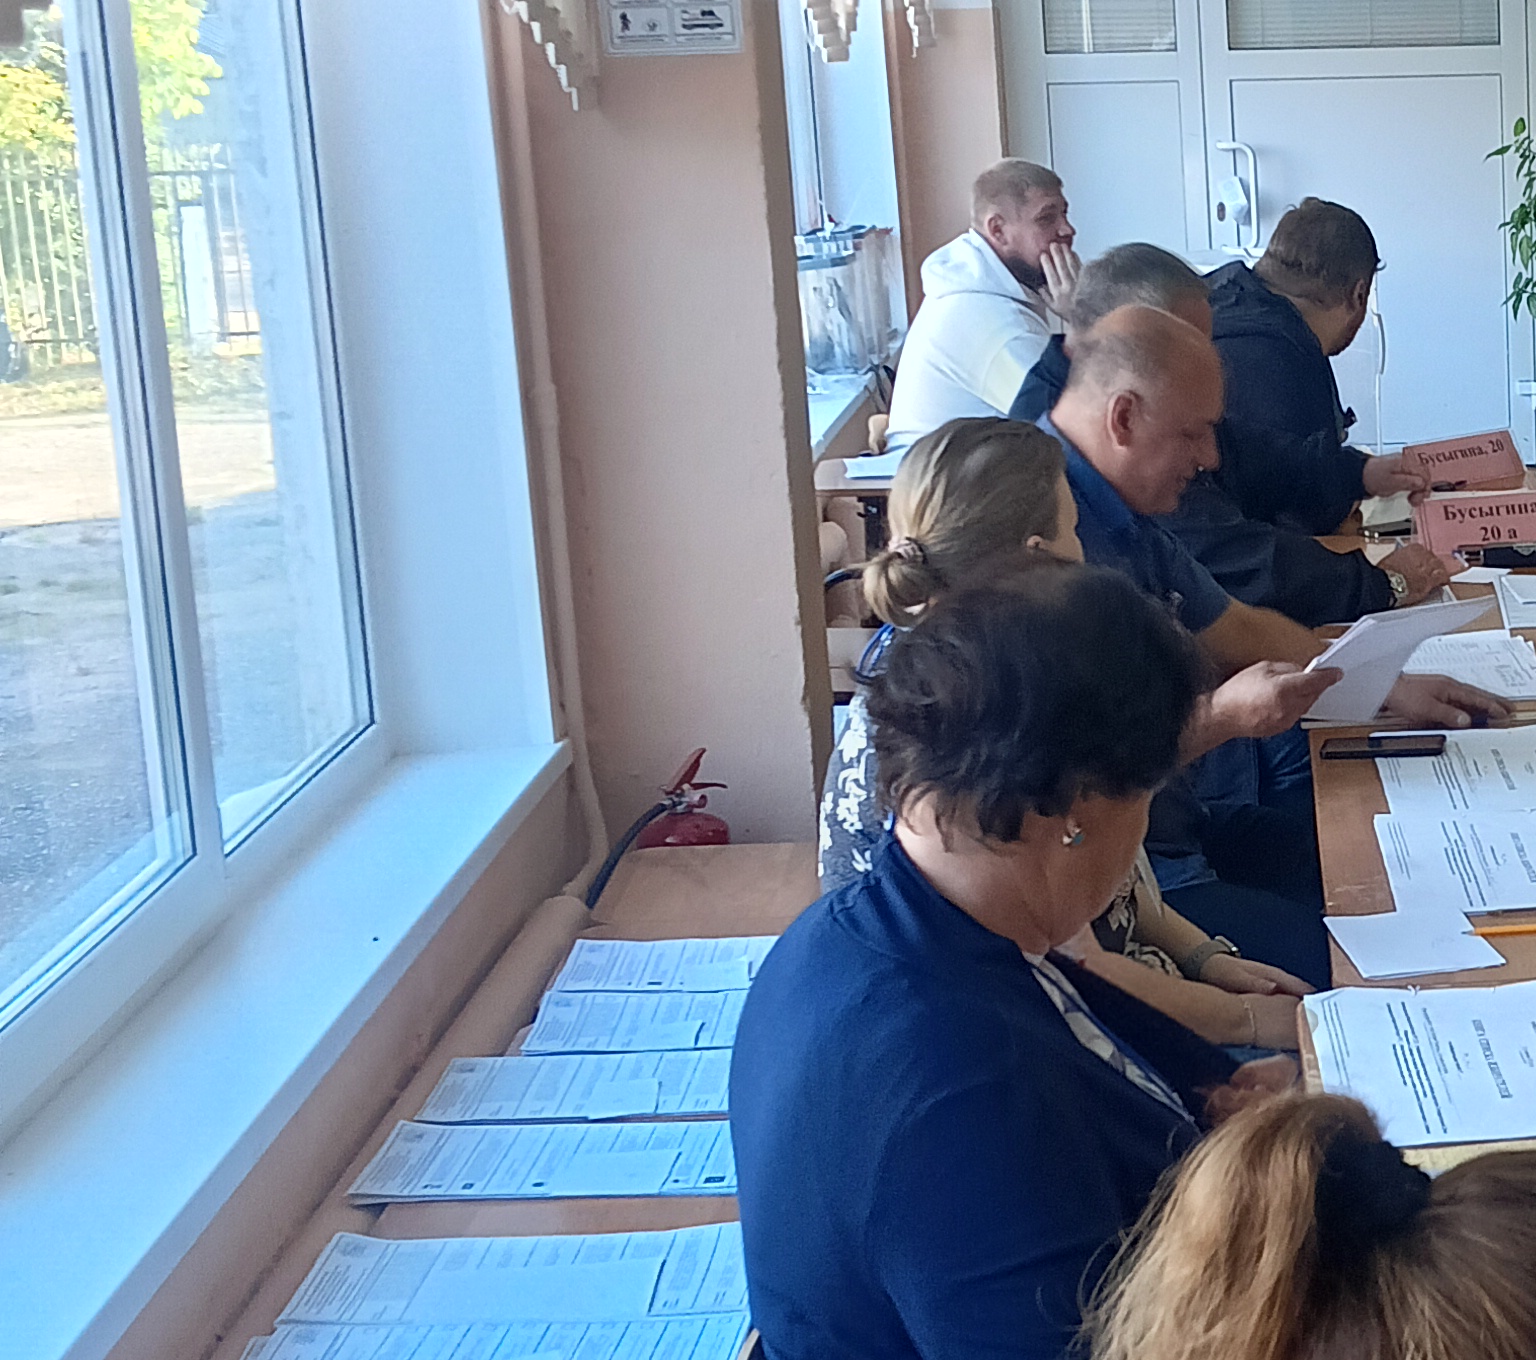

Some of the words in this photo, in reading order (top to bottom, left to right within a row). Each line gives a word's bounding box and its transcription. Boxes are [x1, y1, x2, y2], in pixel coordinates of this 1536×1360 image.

[1417, 447, 1488, 467] Бусыгина,
[1488, 439, 1505, 452] 20
[1479, 525, 1502, 542] 20
